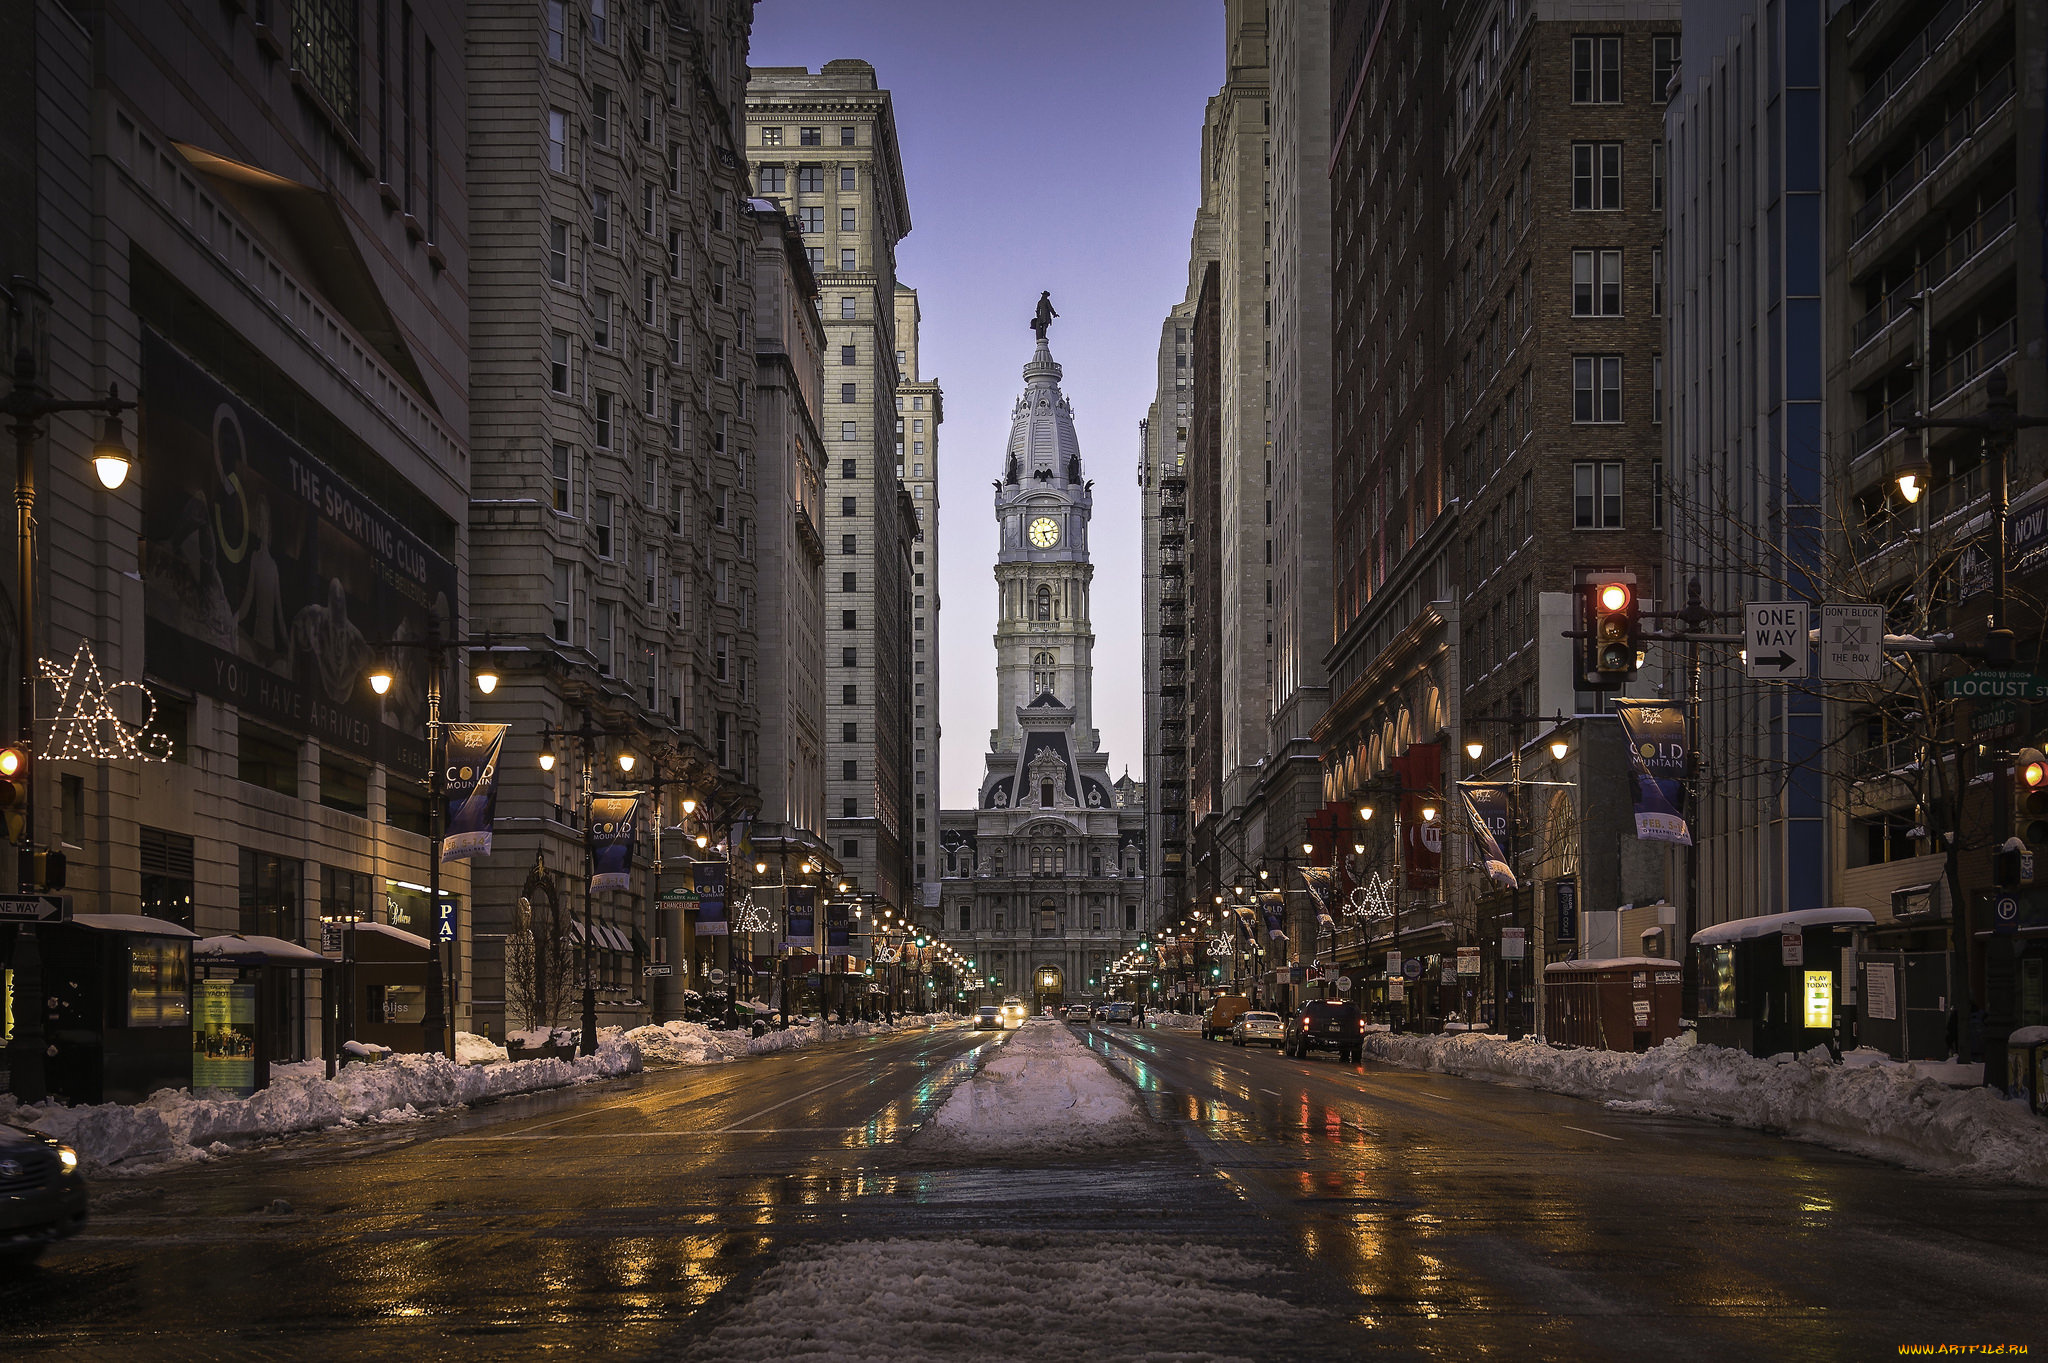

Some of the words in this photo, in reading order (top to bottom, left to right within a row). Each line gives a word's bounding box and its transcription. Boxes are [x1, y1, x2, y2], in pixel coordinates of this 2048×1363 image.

[289, 456, 321, 508] THE
[325, 484, 394, 560] SPORTING
[396, 538, 427, 583] CLUB
[1757, 609, 1796, 626] ONE
[1851, 608, 1880, 617] BLOCK
[1756, 629, 1798, 646] WAY
[1832, 653, 1847, 662] THE
[1852, 653, 1870, 662] BOX
[1998, 671, 2007, 679] W
[1953, 680, 2029, 697] LOCUST
[213, 656, 249, 697] YOU
[260, 678, 302, 720] HAVE
[310, 700, 370, 747] ARRIVED
[1977, 709, 2006, 730] BROAD
[1632, 756, 1683, 768] MUNTAIN
[446, 778, 493, 790] MOUNAIN
[696, 884, 725, 894] COLD
[16, 902, 39, 913] WAY
[789, 904, 813, 913] COLD
[382, 1000, 409, 1013] bliss
